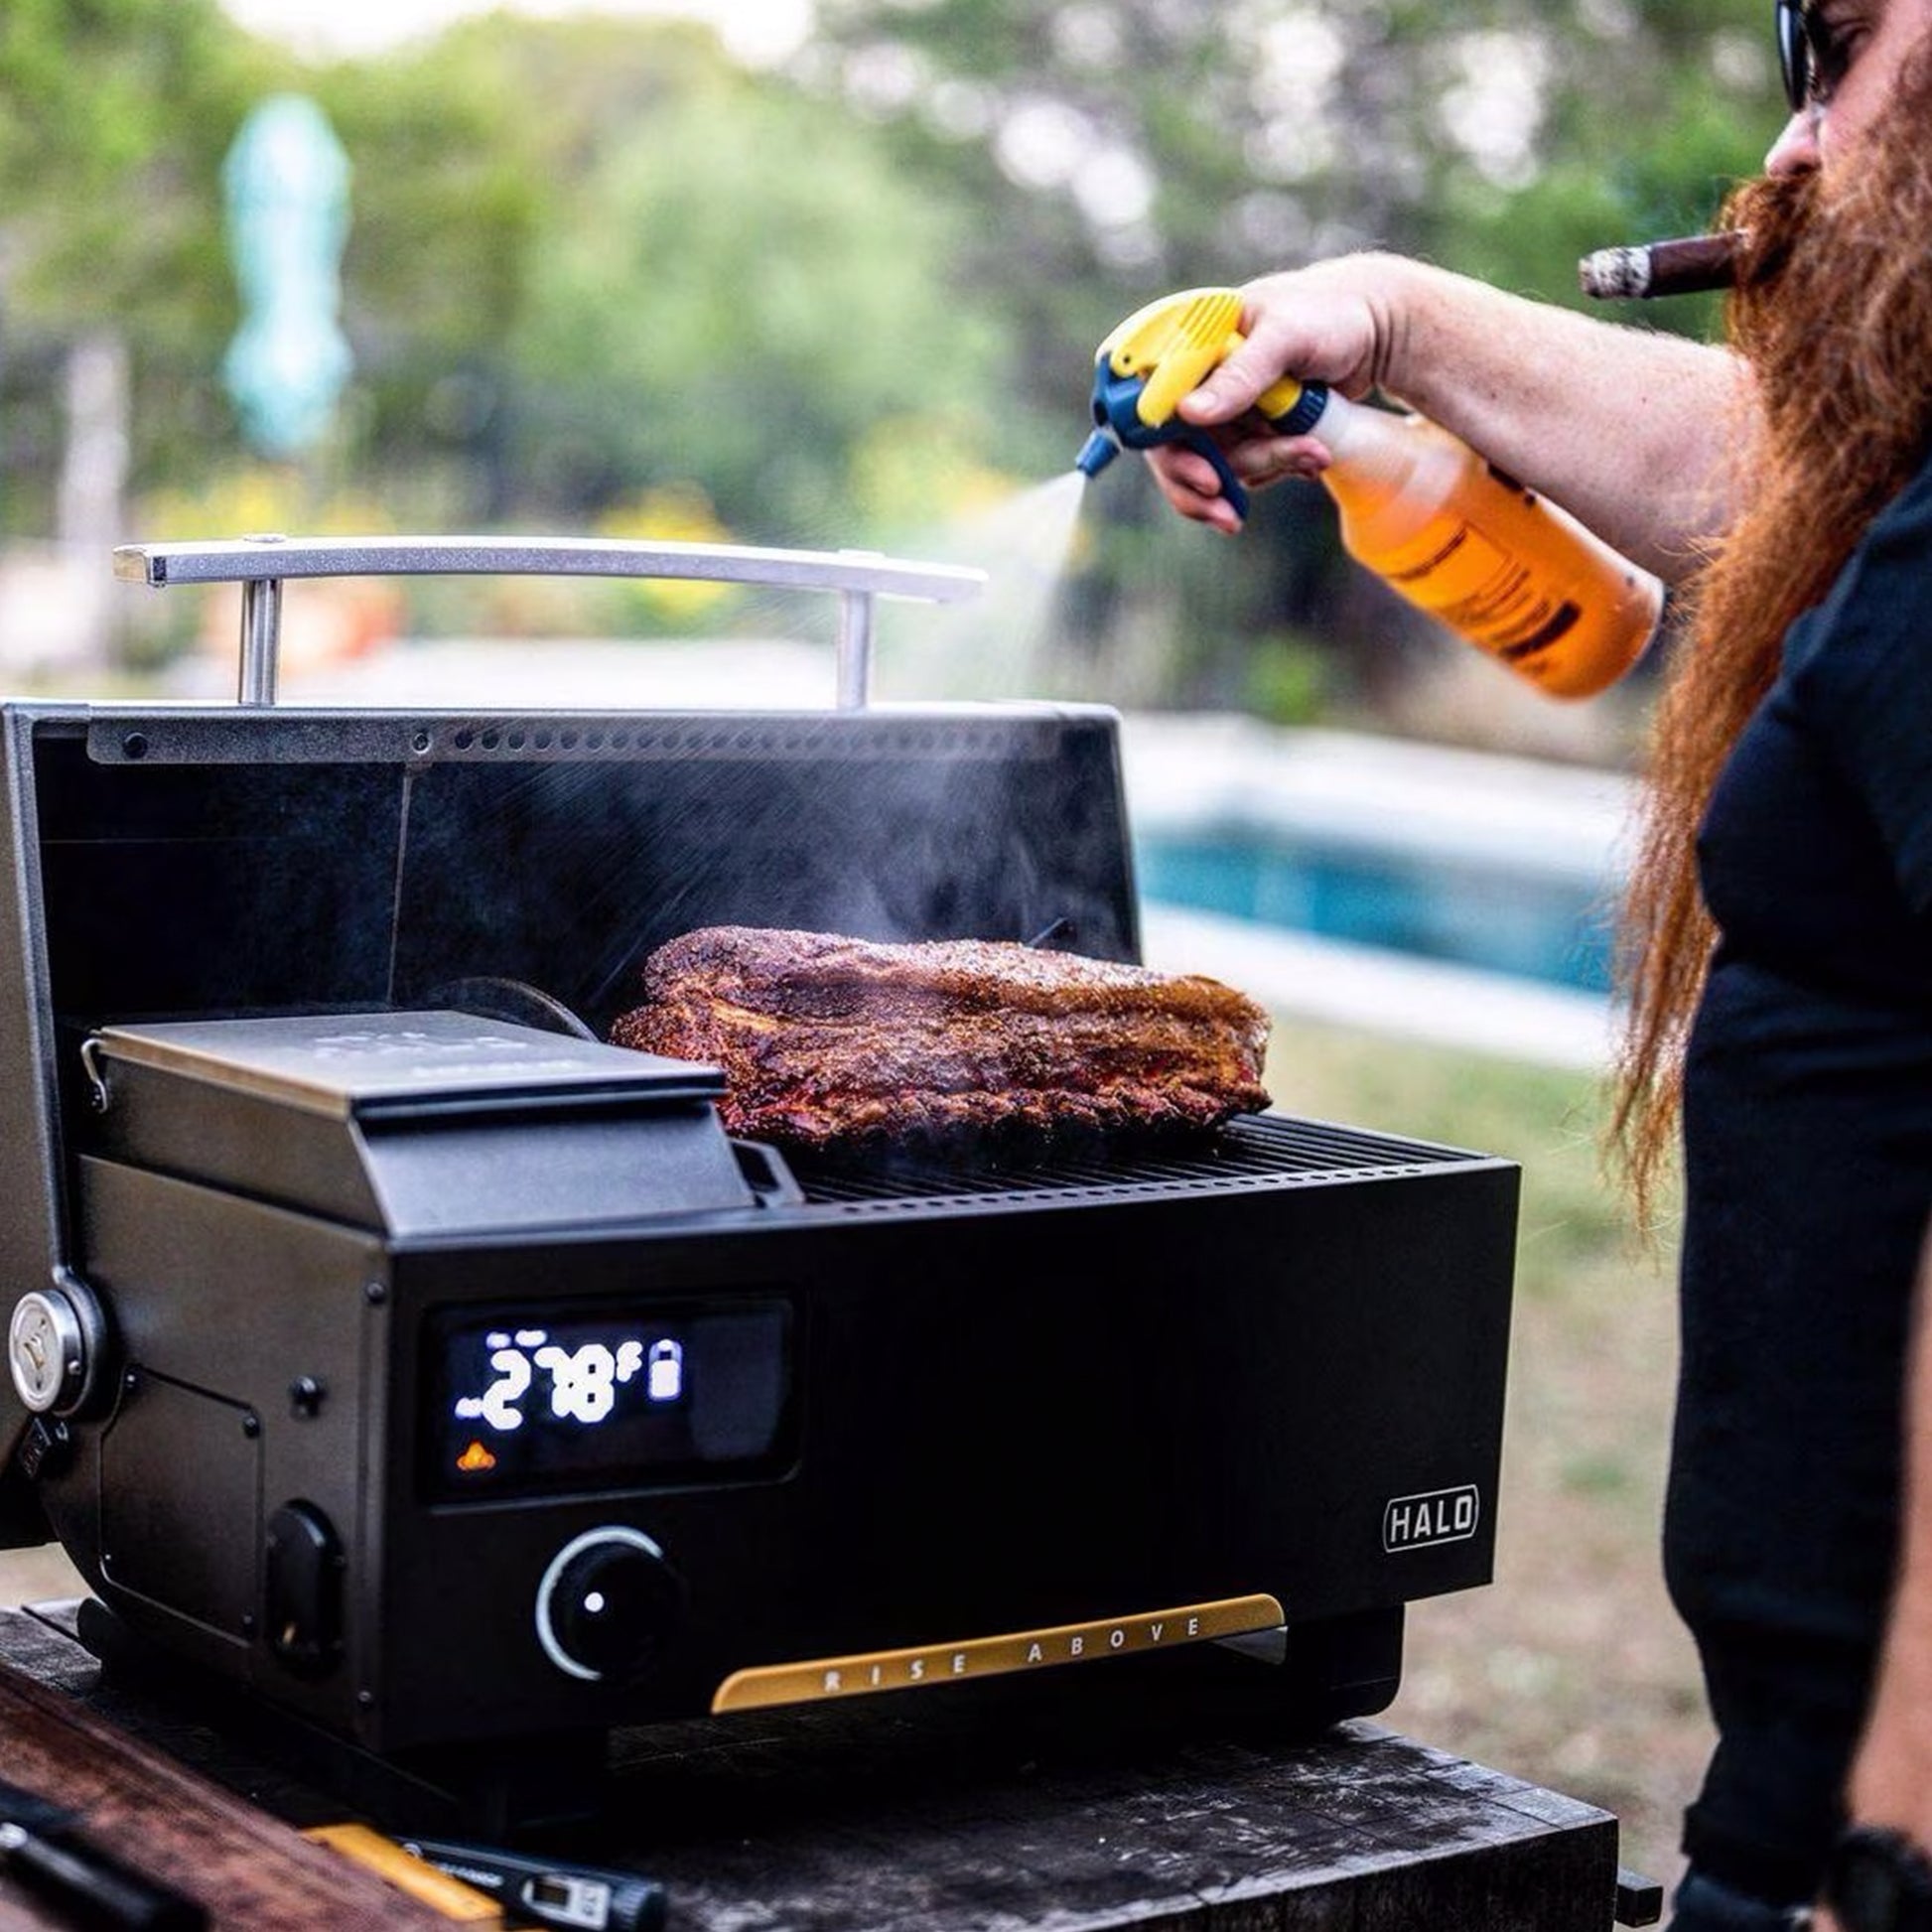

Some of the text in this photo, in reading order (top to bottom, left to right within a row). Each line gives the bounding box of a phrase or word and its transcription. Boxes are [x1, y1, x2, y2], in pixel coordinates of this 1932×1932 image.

[1390, 1494, 1473, 1543] HALO
[824, 1618, 1198, 1694] RISE ABOVE
